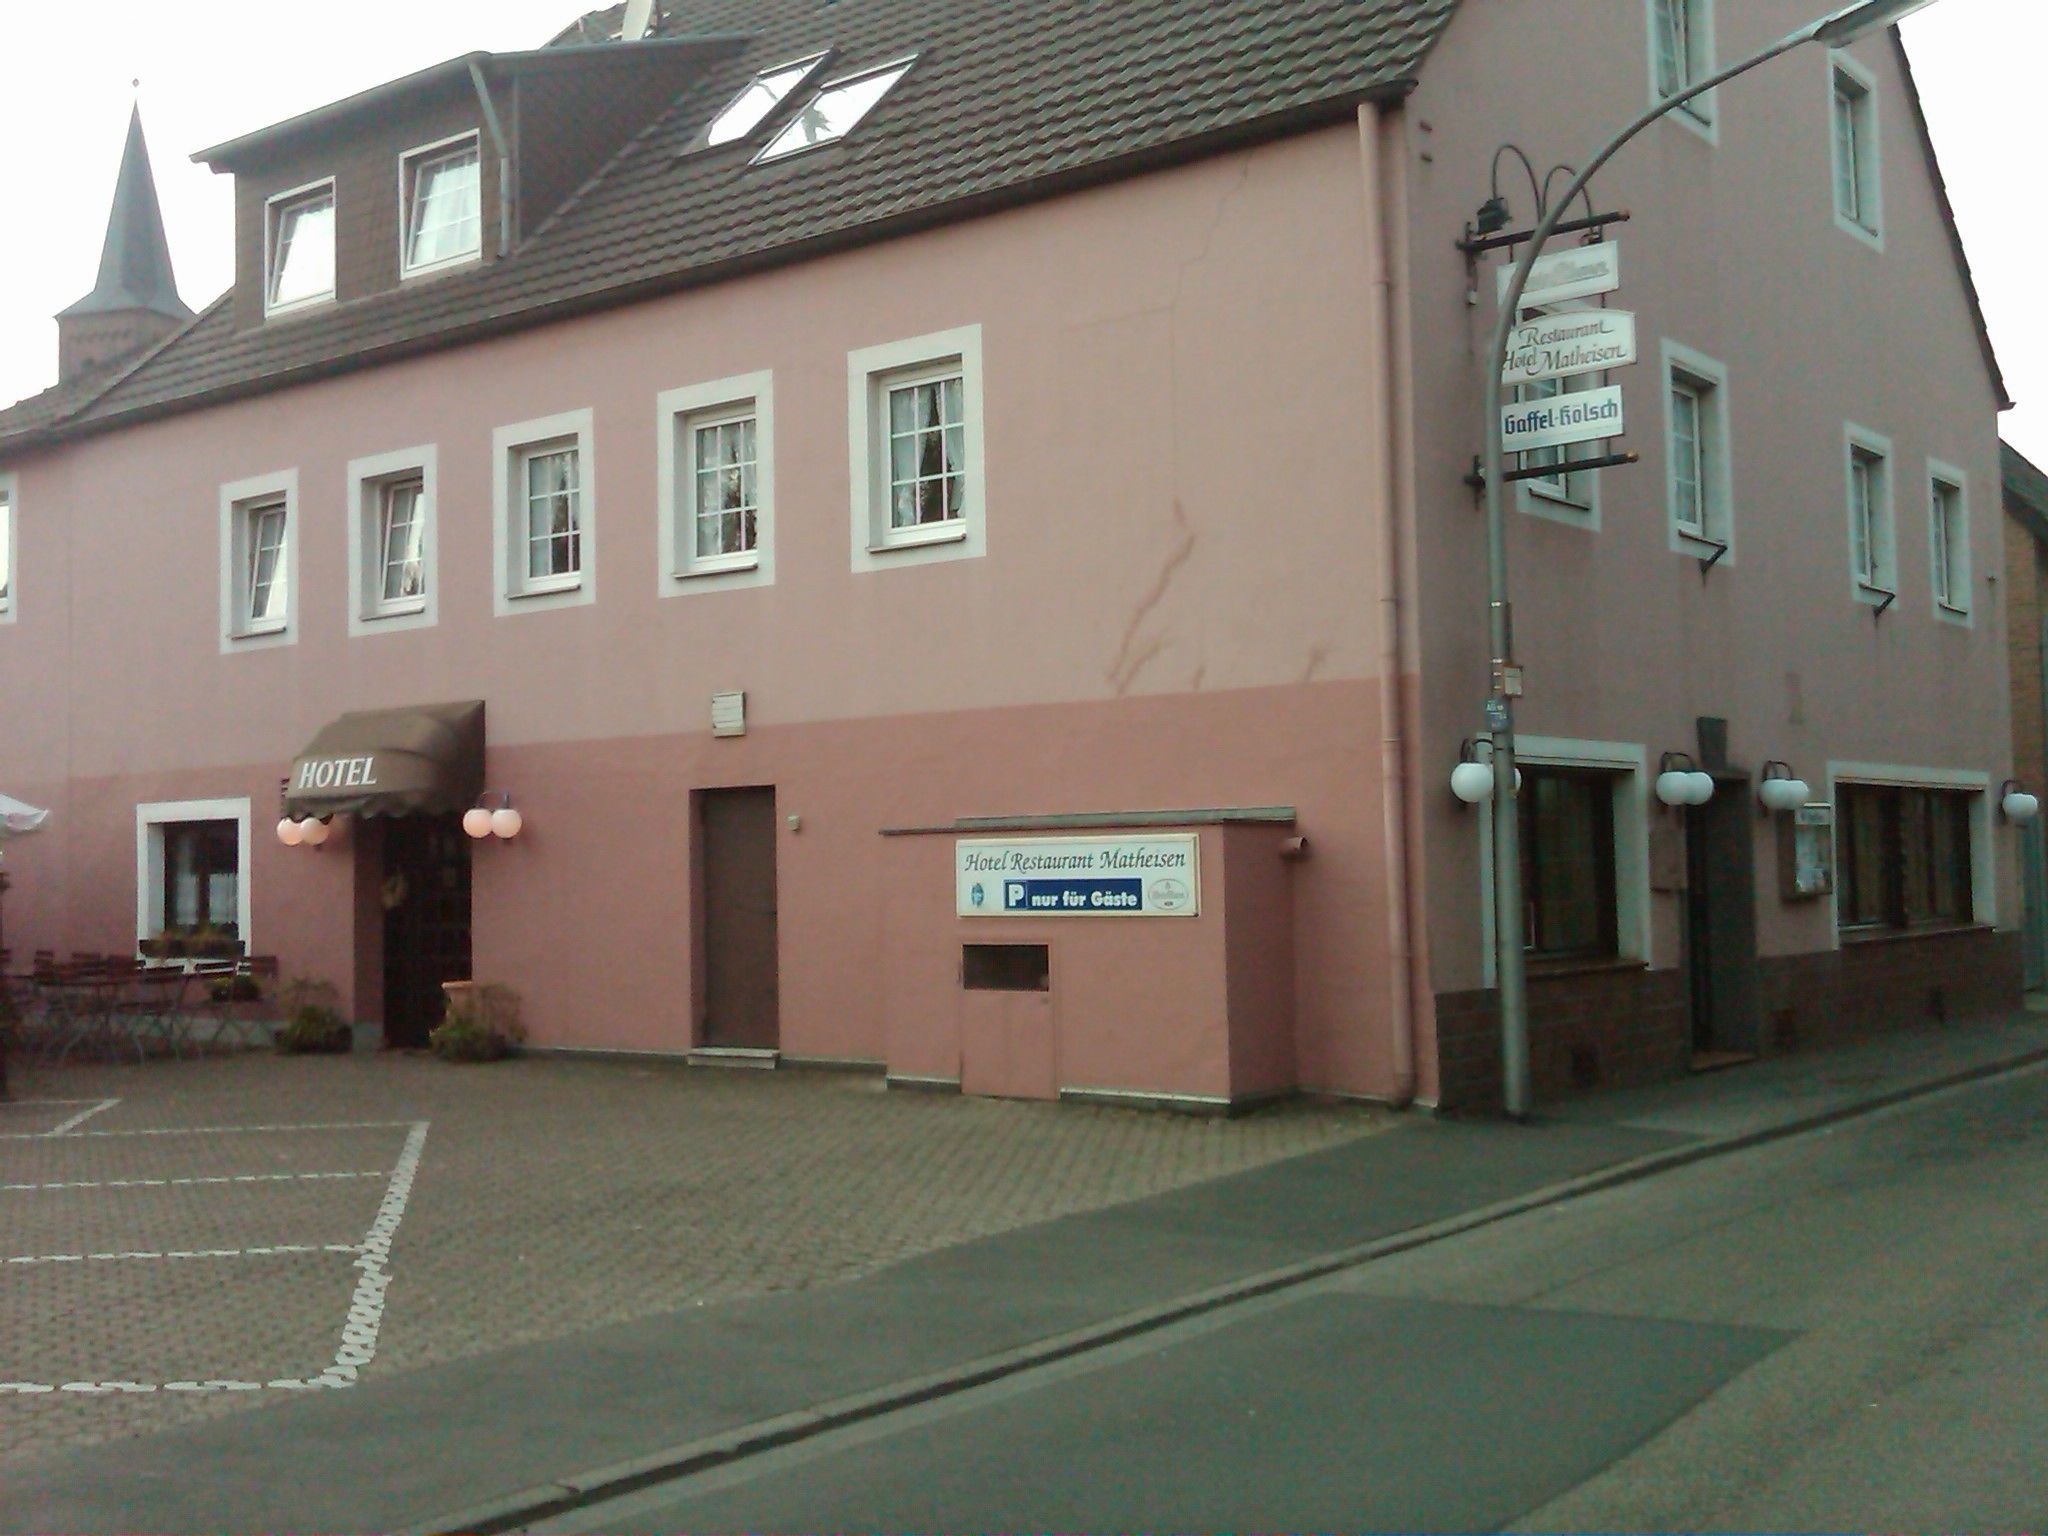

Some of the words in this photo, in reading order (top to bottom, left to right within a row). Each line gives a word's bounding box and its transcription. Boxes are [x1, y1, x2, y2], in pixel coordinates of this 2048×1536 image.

[1519, 320, 1614, 349] Restaurant
[1504, 347, 1537, 371] Hotel
[1526, 344, 1626, 376] Matheisen
[298, 756, 377, 789] HOTEL
[964, 851, 1009, 871] Hotel
[1010, 852, 1094, 875] Restaurant
[1100, 847, 1185, 869] Matheisen
[1008, 884, 1024, 906] P
[1031, 893, 1058, 906] nur
[1062, 890, 1086, 906] für
[1091, 890, 1137, 906] Gäste
